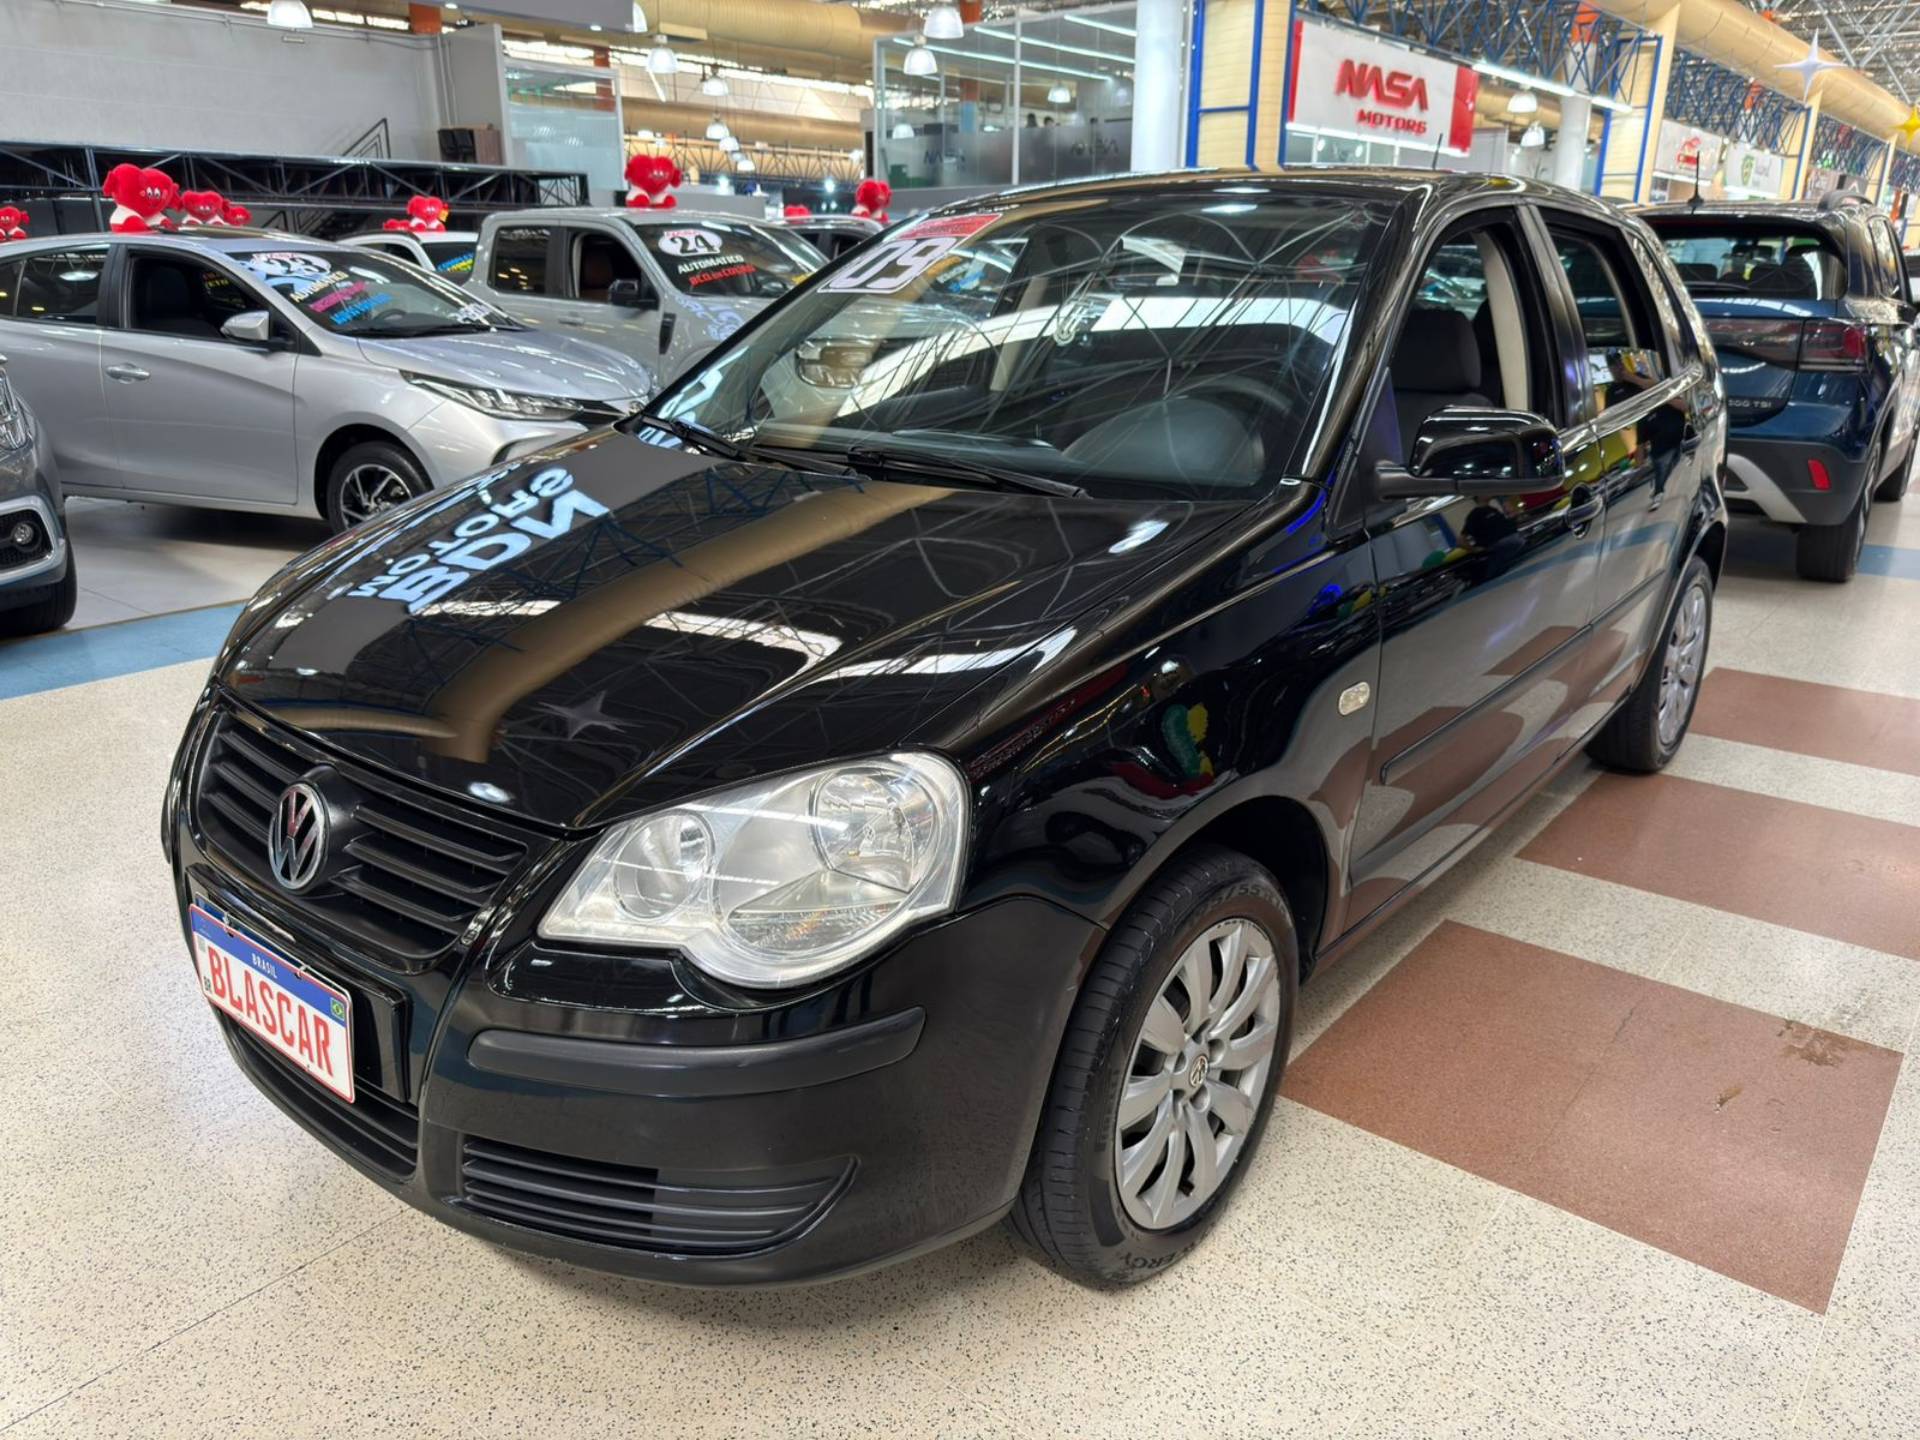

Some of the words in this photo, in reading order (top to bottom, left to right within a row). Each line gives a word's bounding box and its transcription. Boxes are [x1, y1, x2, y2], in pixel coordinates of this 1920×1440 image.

[1335, 59, 1428, 112] NASA
[1357, 109, 1427, 134] MOTORS
[670, 234, 718, 254] 24
[829, 237, 957, 289] 09
[252, 953, 278, 979] BRASIL
[207, 946, 334, 1078] BLASCAR
